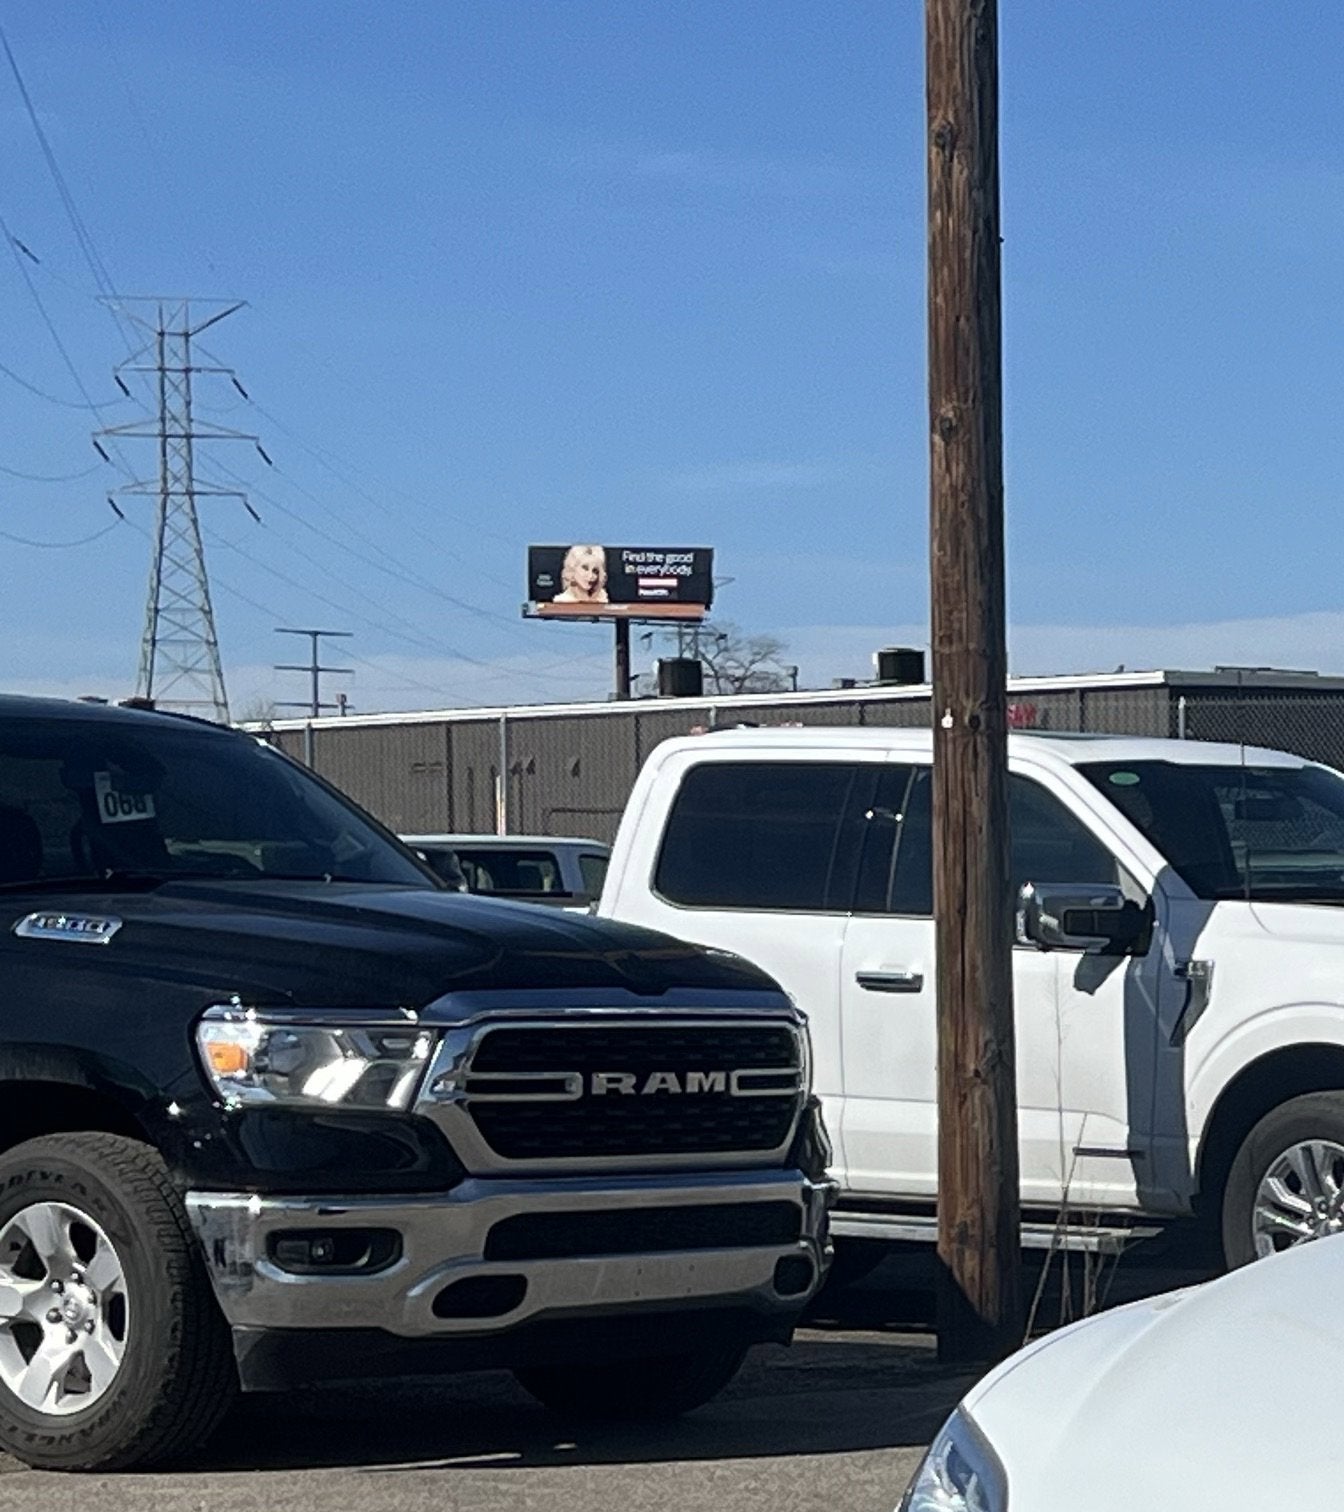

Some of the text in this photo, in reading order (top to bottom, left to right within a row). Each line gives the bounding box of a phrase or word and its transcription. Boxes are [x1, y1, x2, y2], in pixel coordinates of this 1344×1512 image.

[622, 550, 694, 564] Find the good
[591, 1071, 726, 1096] RAM
